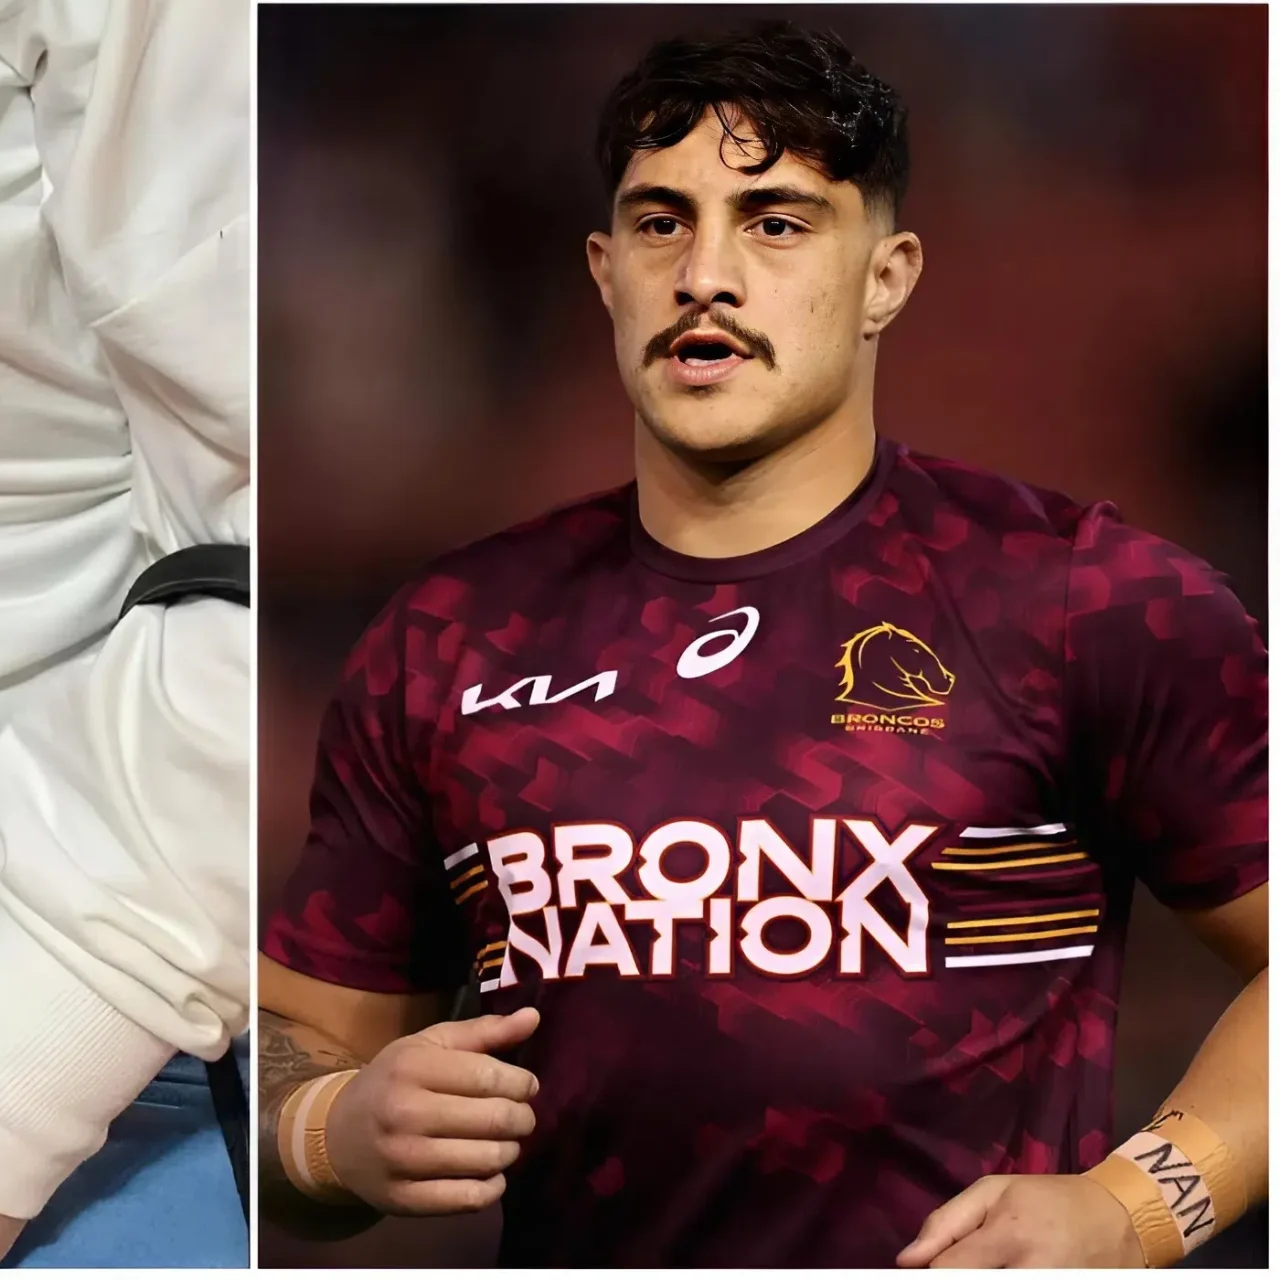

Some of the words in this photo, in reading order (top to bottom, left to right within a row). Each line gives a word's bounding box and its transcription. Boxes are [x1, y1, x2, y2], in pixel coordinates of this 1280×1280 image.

[830, 713, 946, 729] BRONCOS
[486, 818, 938, 913] BRONX
[498, 895, 930, 988] NATION
[1133, 1142, 1217, 1238] NAN
